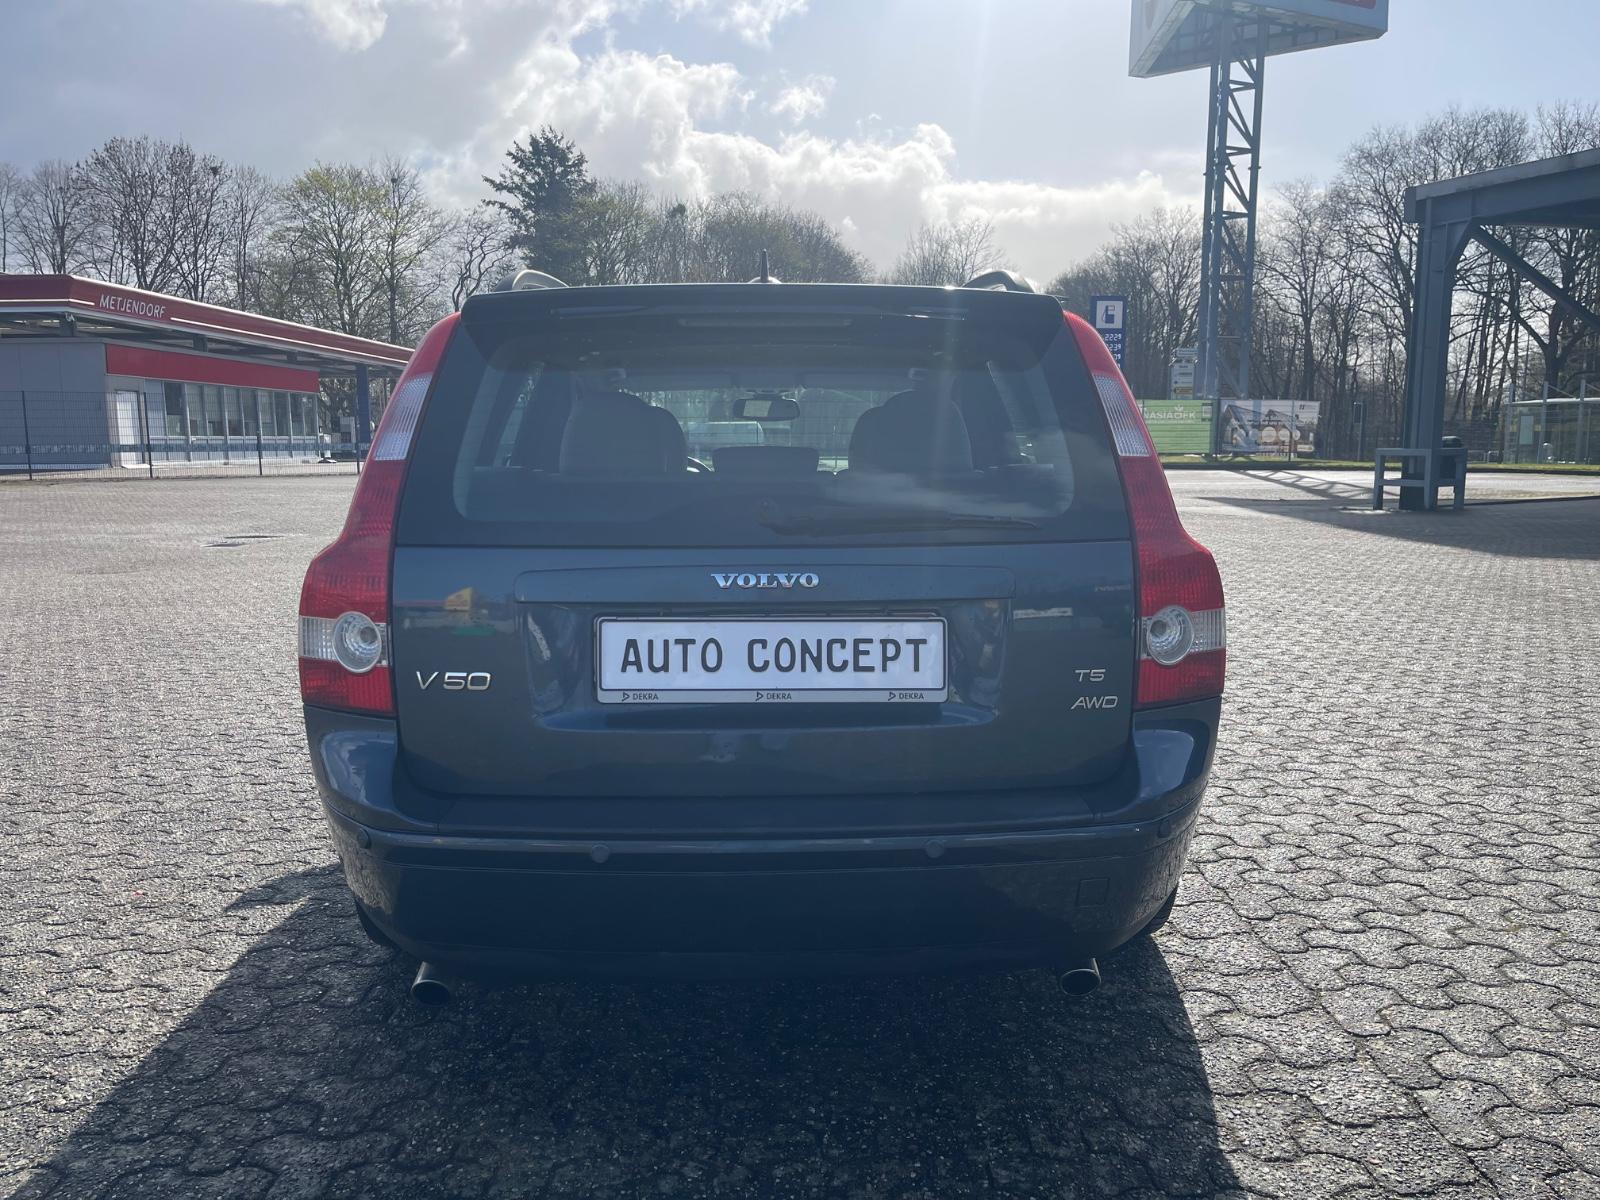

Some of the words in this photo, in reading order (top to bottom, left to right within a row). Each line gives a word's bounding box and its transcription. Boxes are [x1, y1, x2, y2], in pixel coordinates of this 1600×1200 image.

[100, 294, 166, 318] METJENDORF
[711, 572, 820, 589] VOLVO
[621, 637, 724, 673] AUTO
[747, 637, 928, 673] CONCEPT
[1075, 668, 1106, 682] T5
[632, 692, 659, 701] DEKRA
[766, 692, 792, 701] DEKRA
[898, 692, 924, 701] DEKRA
[1070, 695, 1118, 710] AWD
